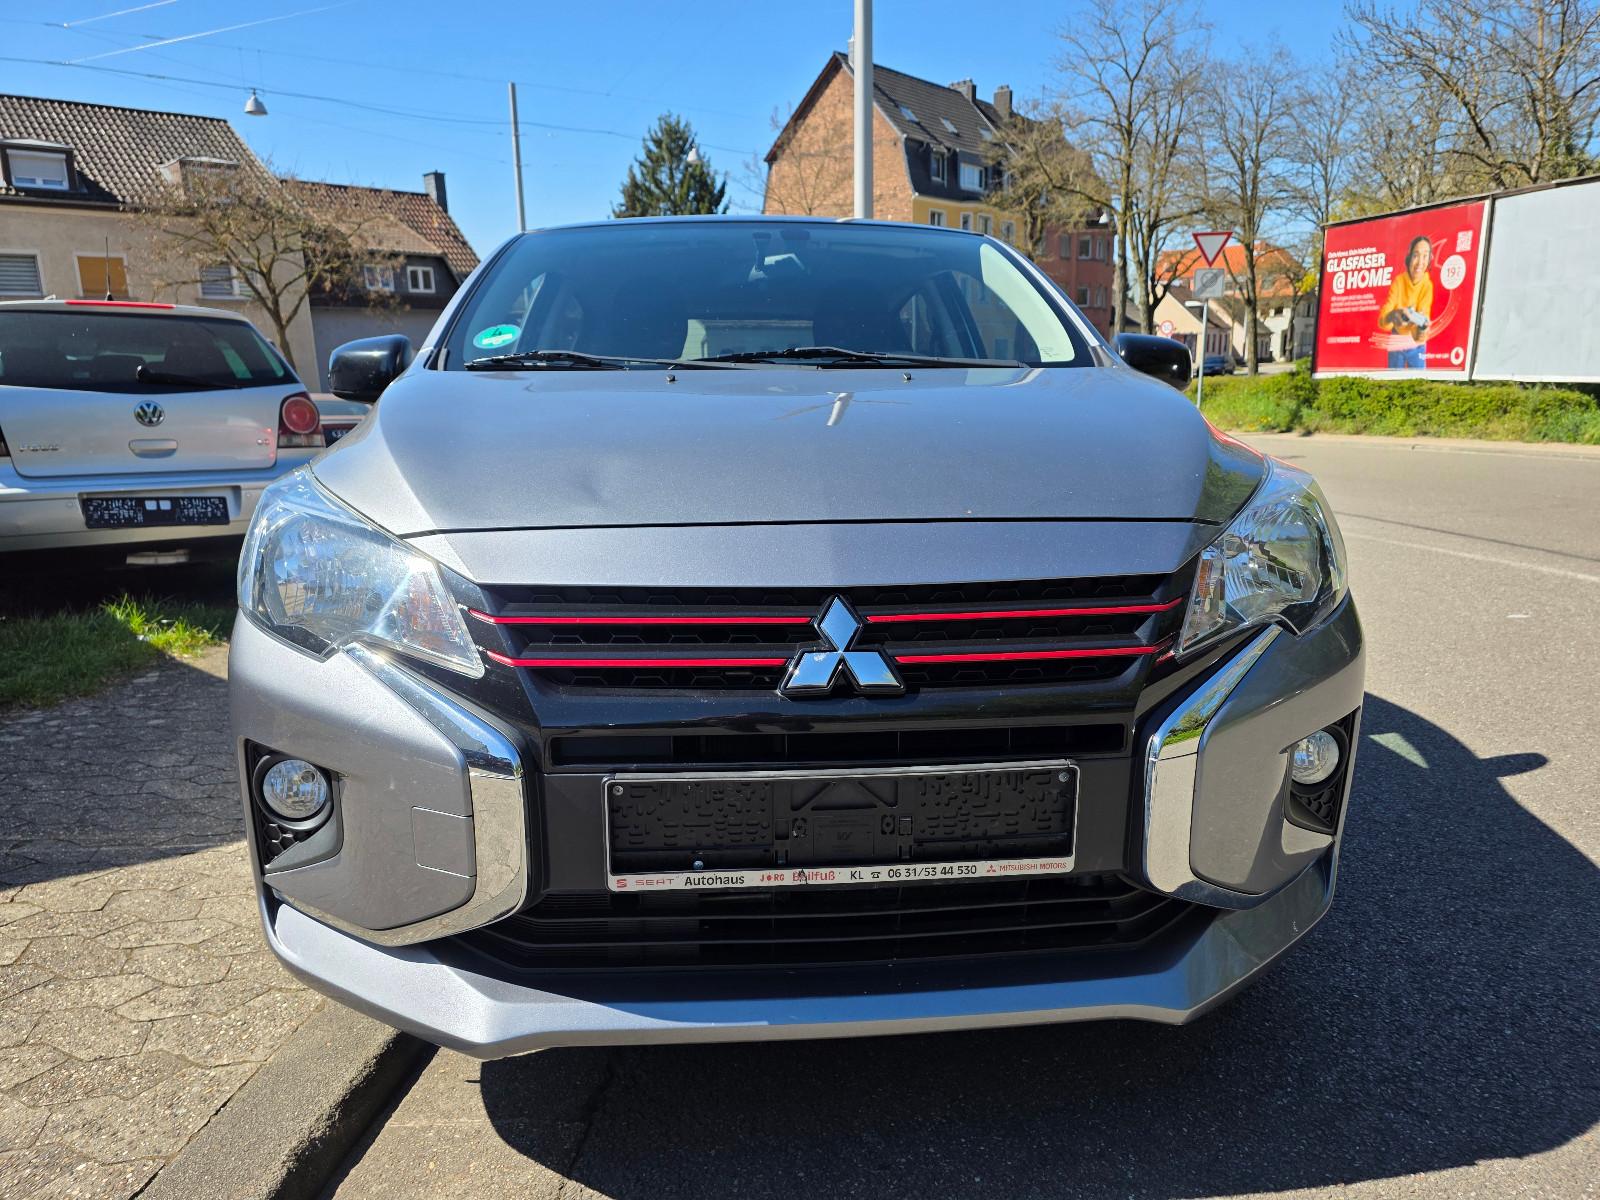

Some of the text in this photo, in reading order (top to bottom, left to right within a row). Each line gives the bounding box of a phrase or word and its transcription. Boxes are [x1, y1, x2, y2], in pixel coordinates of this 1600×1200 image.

[1327, 253, 1386, 272] GLASFASER
[635, 878, 675, 886] SEAT
[684, 875, 745, 886] Autohaus
[792, 870, 835, 882] Bilfuß
[850, 870, 864, 880] KL
[887, 869, 901, 878] 06
[904, 867, 937, 878] 31/53
[940, 866, 954, 876] 44
[957, 865, 977, 875] 530
[999, 864, 1038, 872] MITSUBISHI
[1040, 862, 1067, 870] MOTORS
